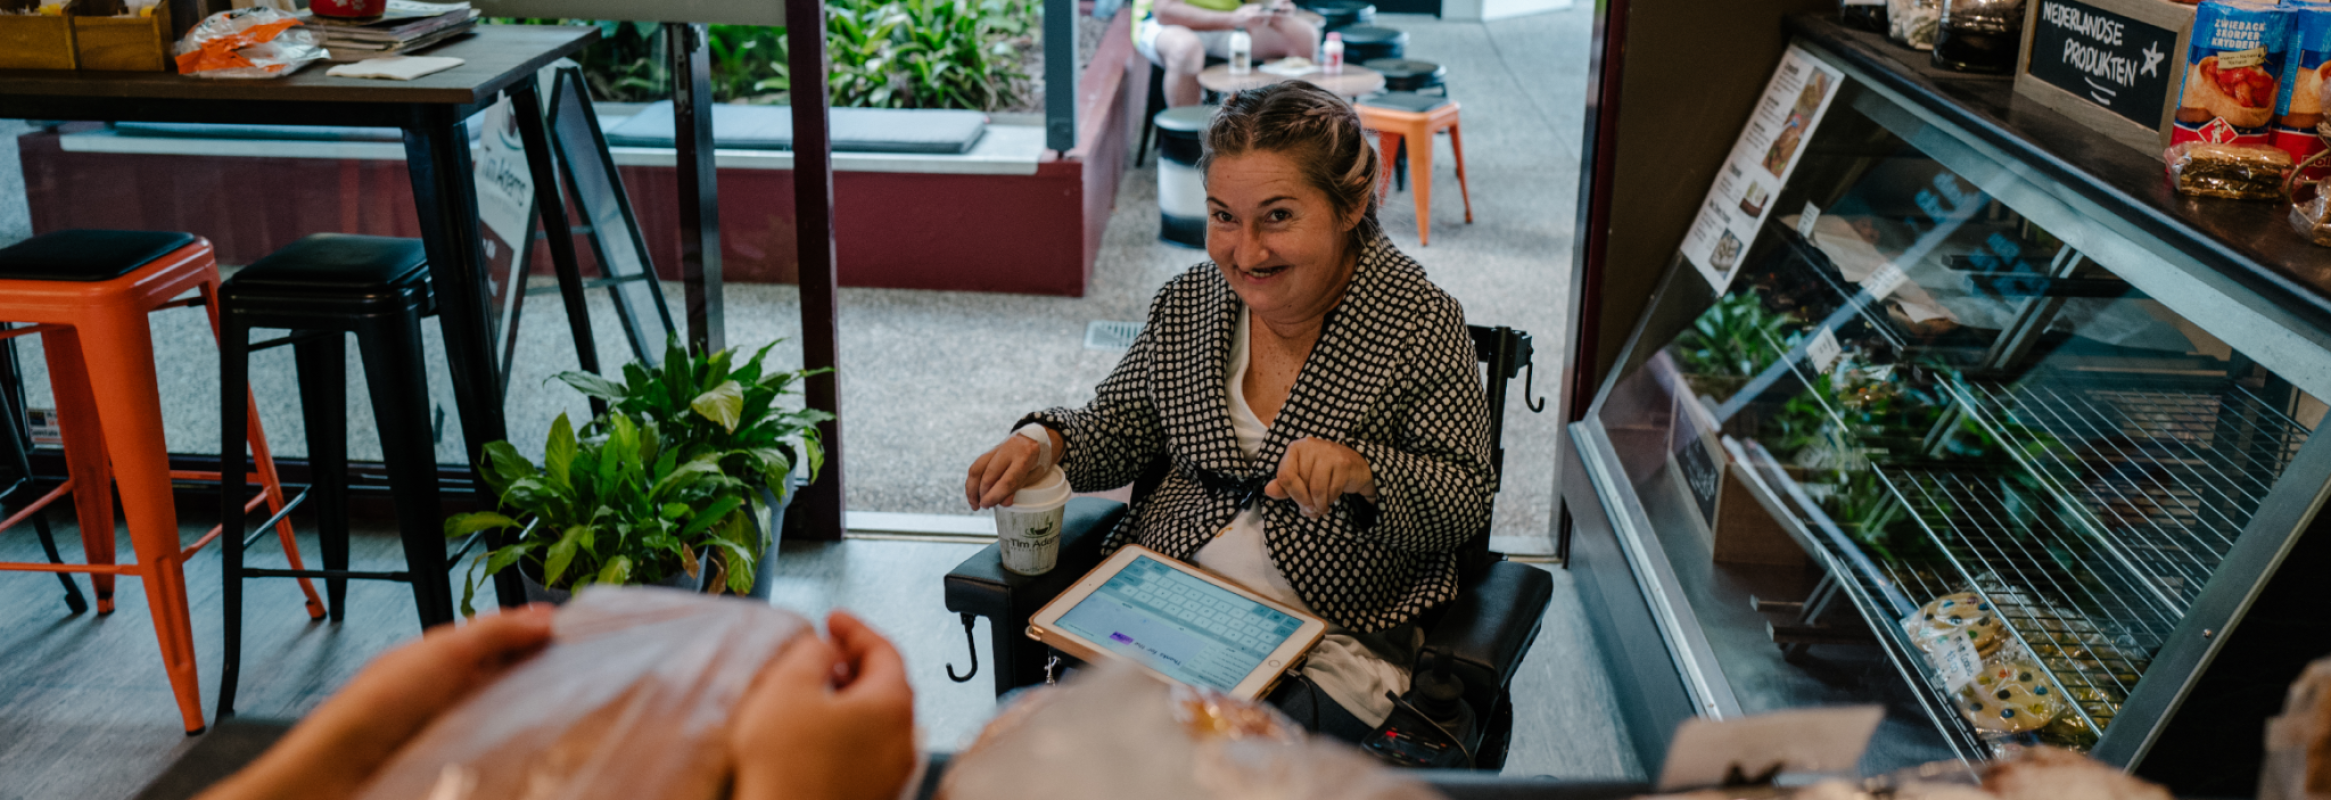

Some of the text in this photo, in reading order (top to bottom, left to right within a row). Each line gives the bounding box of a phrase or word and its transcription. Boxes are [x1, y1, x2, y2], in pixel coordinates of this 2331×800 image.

[2043, 1, 2125, 46] NEDERLANDSE
[2214, 18, 2266, 32] ZWIEBACK
[2062, 37, 2138, 87] PRODUKTEN
[1010, 537, 1030, 549] Tim
[1146, 647, 1158, 656] for
[1159, 652, 1182, 667] Thanks
